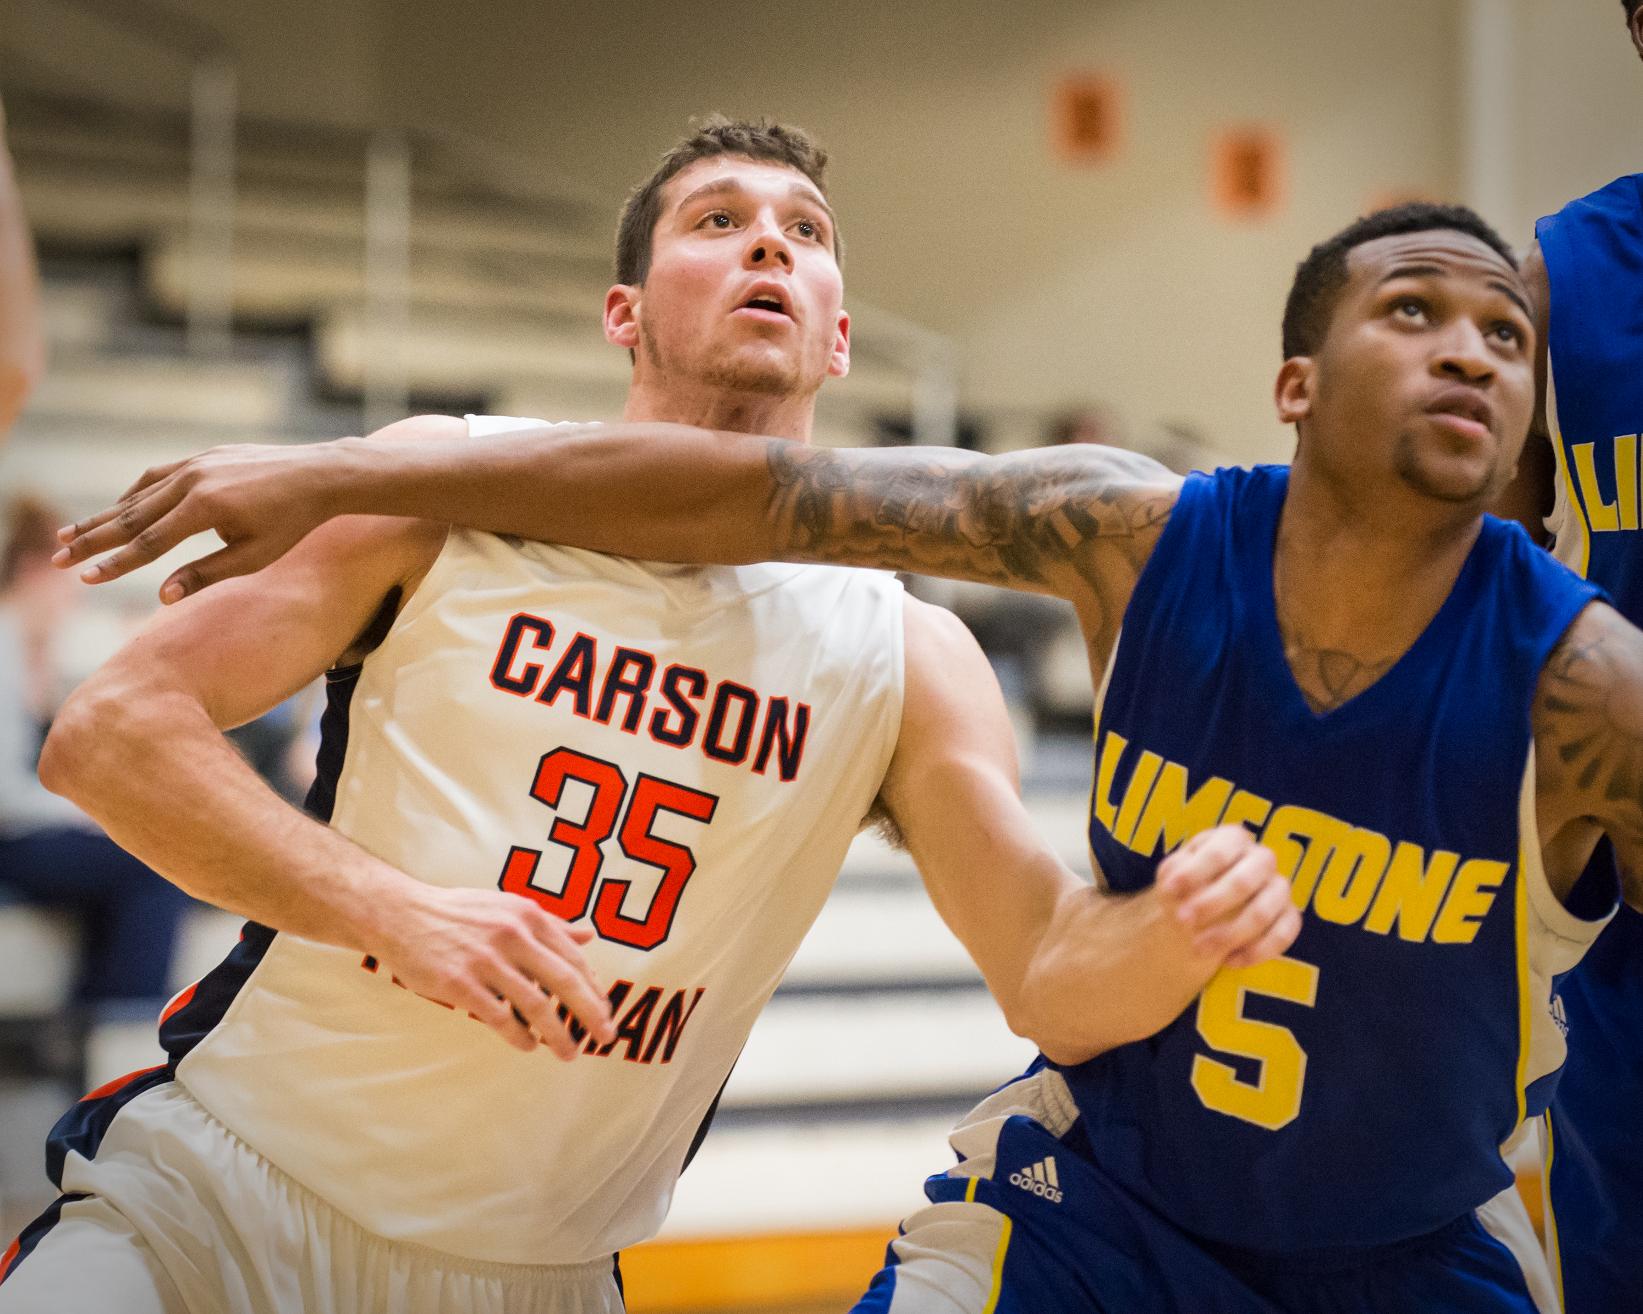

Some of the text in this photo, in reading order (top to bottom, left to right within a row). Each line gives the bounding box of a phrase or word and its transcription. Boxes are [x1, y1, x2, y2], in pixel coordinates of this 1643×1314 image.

[489, 612, 811, 782] CARSON
[497, 746, 720, 952] 35
[1190, 956, 1320, 1131] 5
[1009, 1172, 1064, 1204] adidas
